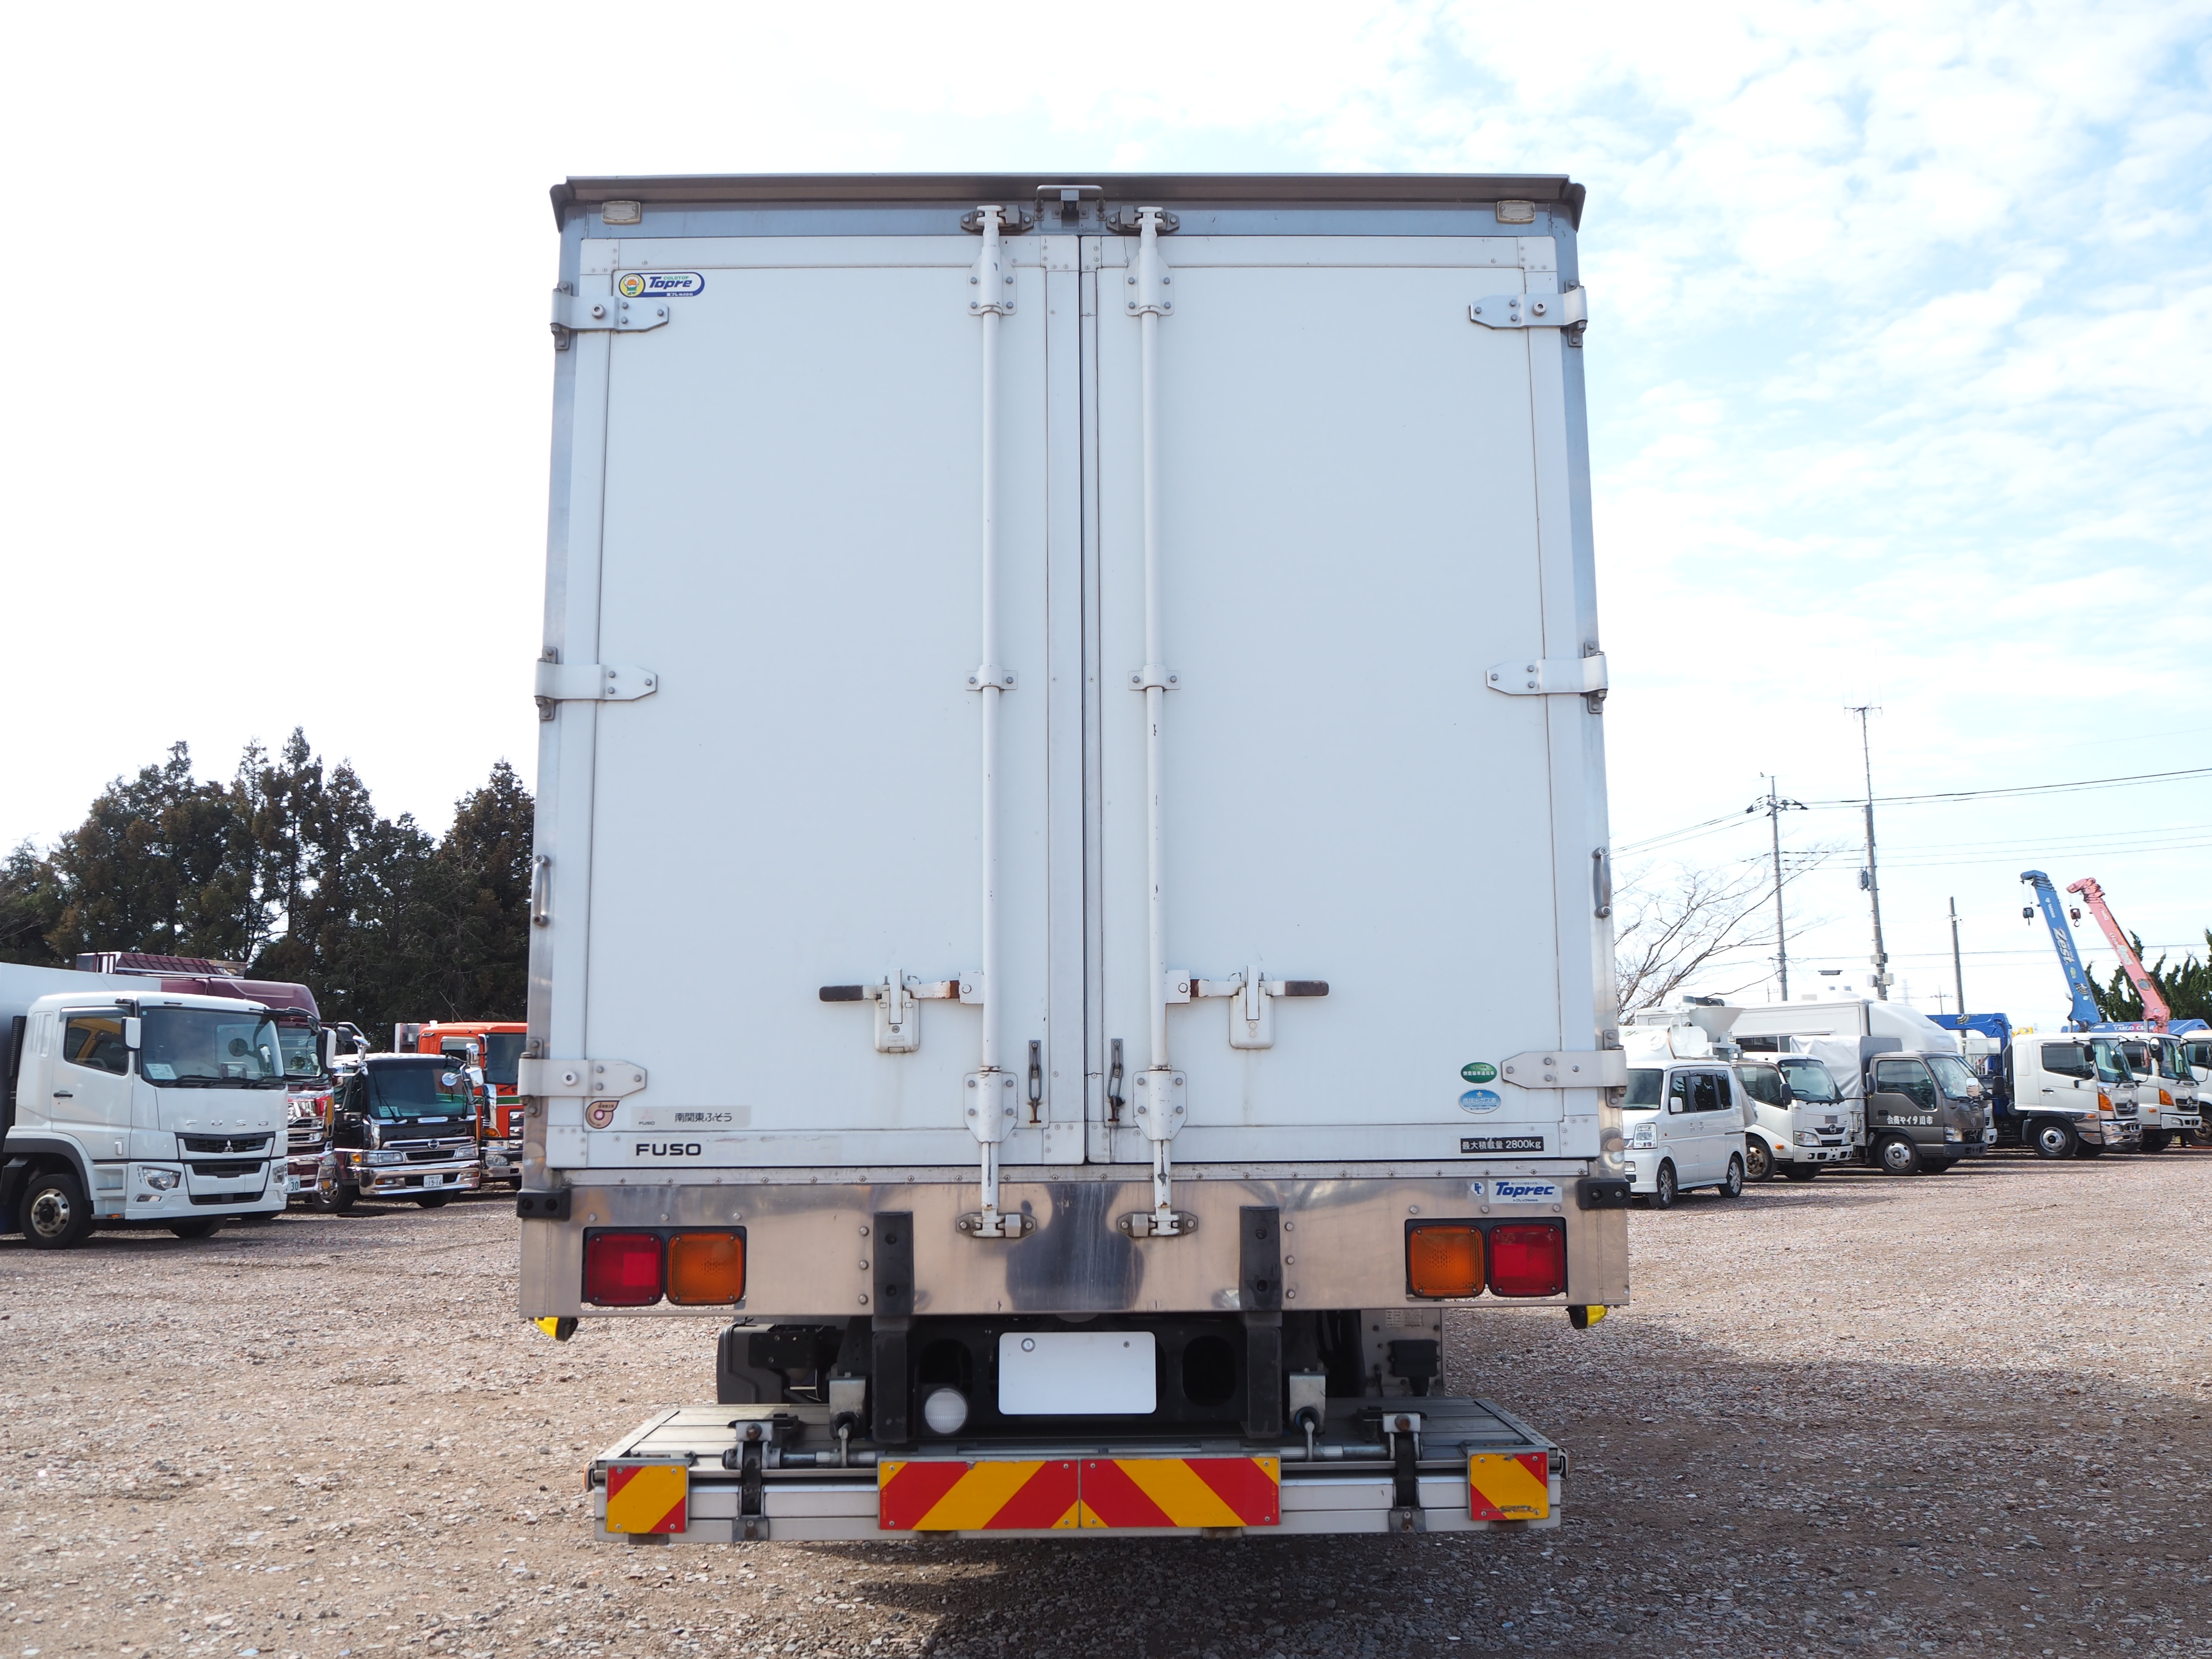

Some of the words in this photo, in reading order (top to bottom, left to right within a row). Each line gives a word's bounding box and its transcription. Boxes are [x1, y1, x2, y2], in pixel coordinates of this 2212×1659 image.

[649, 276, 692, 289] Topre
[2052, 927, 2075, 964] Zest
[675, 1112, 732, 1123] 南関東ふそう
[636, 1143, 701, 1156] FUSO
[1462, 1141, 1503, 1150] 最大積載量
[1505, 1139, 1541, 1149] 2800kg
[1496, 1182, 1555, 1198] Toprec
